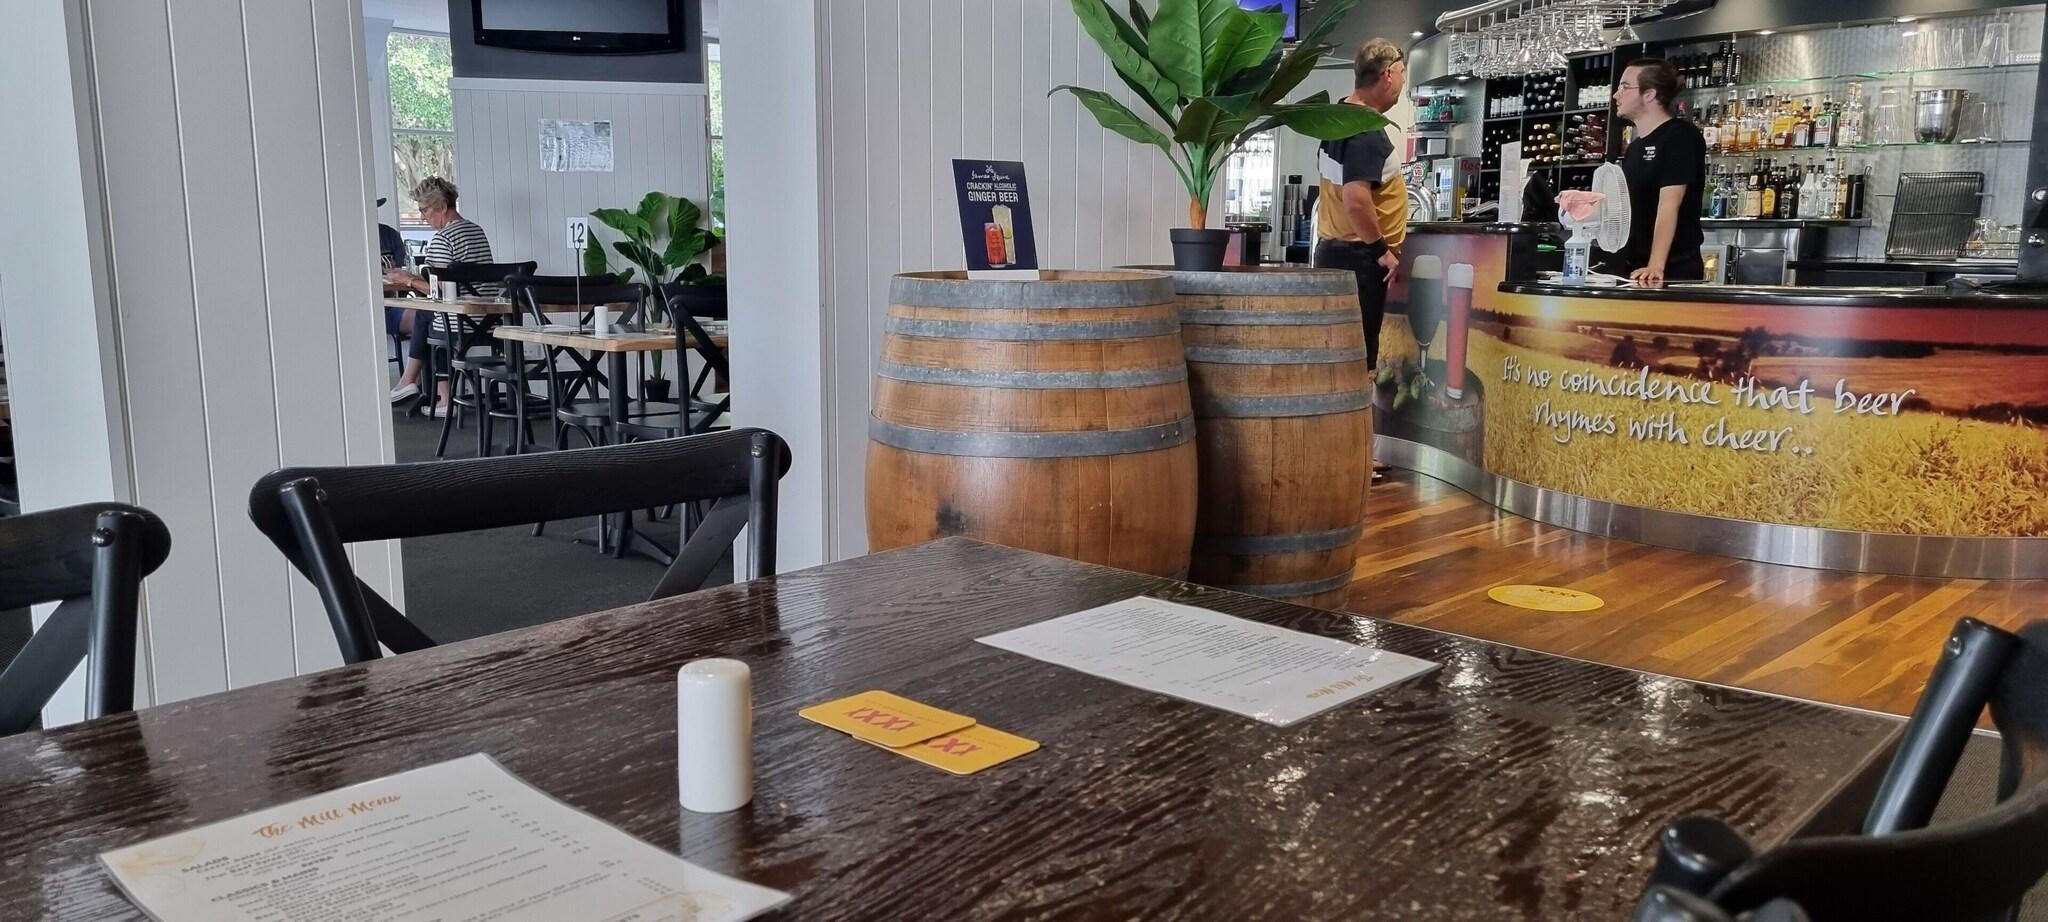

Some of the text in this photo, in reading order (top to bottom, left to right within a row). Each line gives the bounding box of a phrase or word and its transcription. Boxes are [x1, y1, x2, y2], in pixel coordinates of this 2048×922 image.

[966, 182, 993, 190] CRACKIN'
[968, 191, 1019, 203] GINGER BEER
[570, 222, 584, 243] 12
[1502, 355, 1917, 416] It's no coincidence that beer
[1535, 399, 1616, 443] rhymes
[1629, 414, 1687, 445] with
[843, 707, 920, 731] XXXX
[252, 795, 401, 838] The Mill Menu
[181, 856, 230, 873] SALADS
